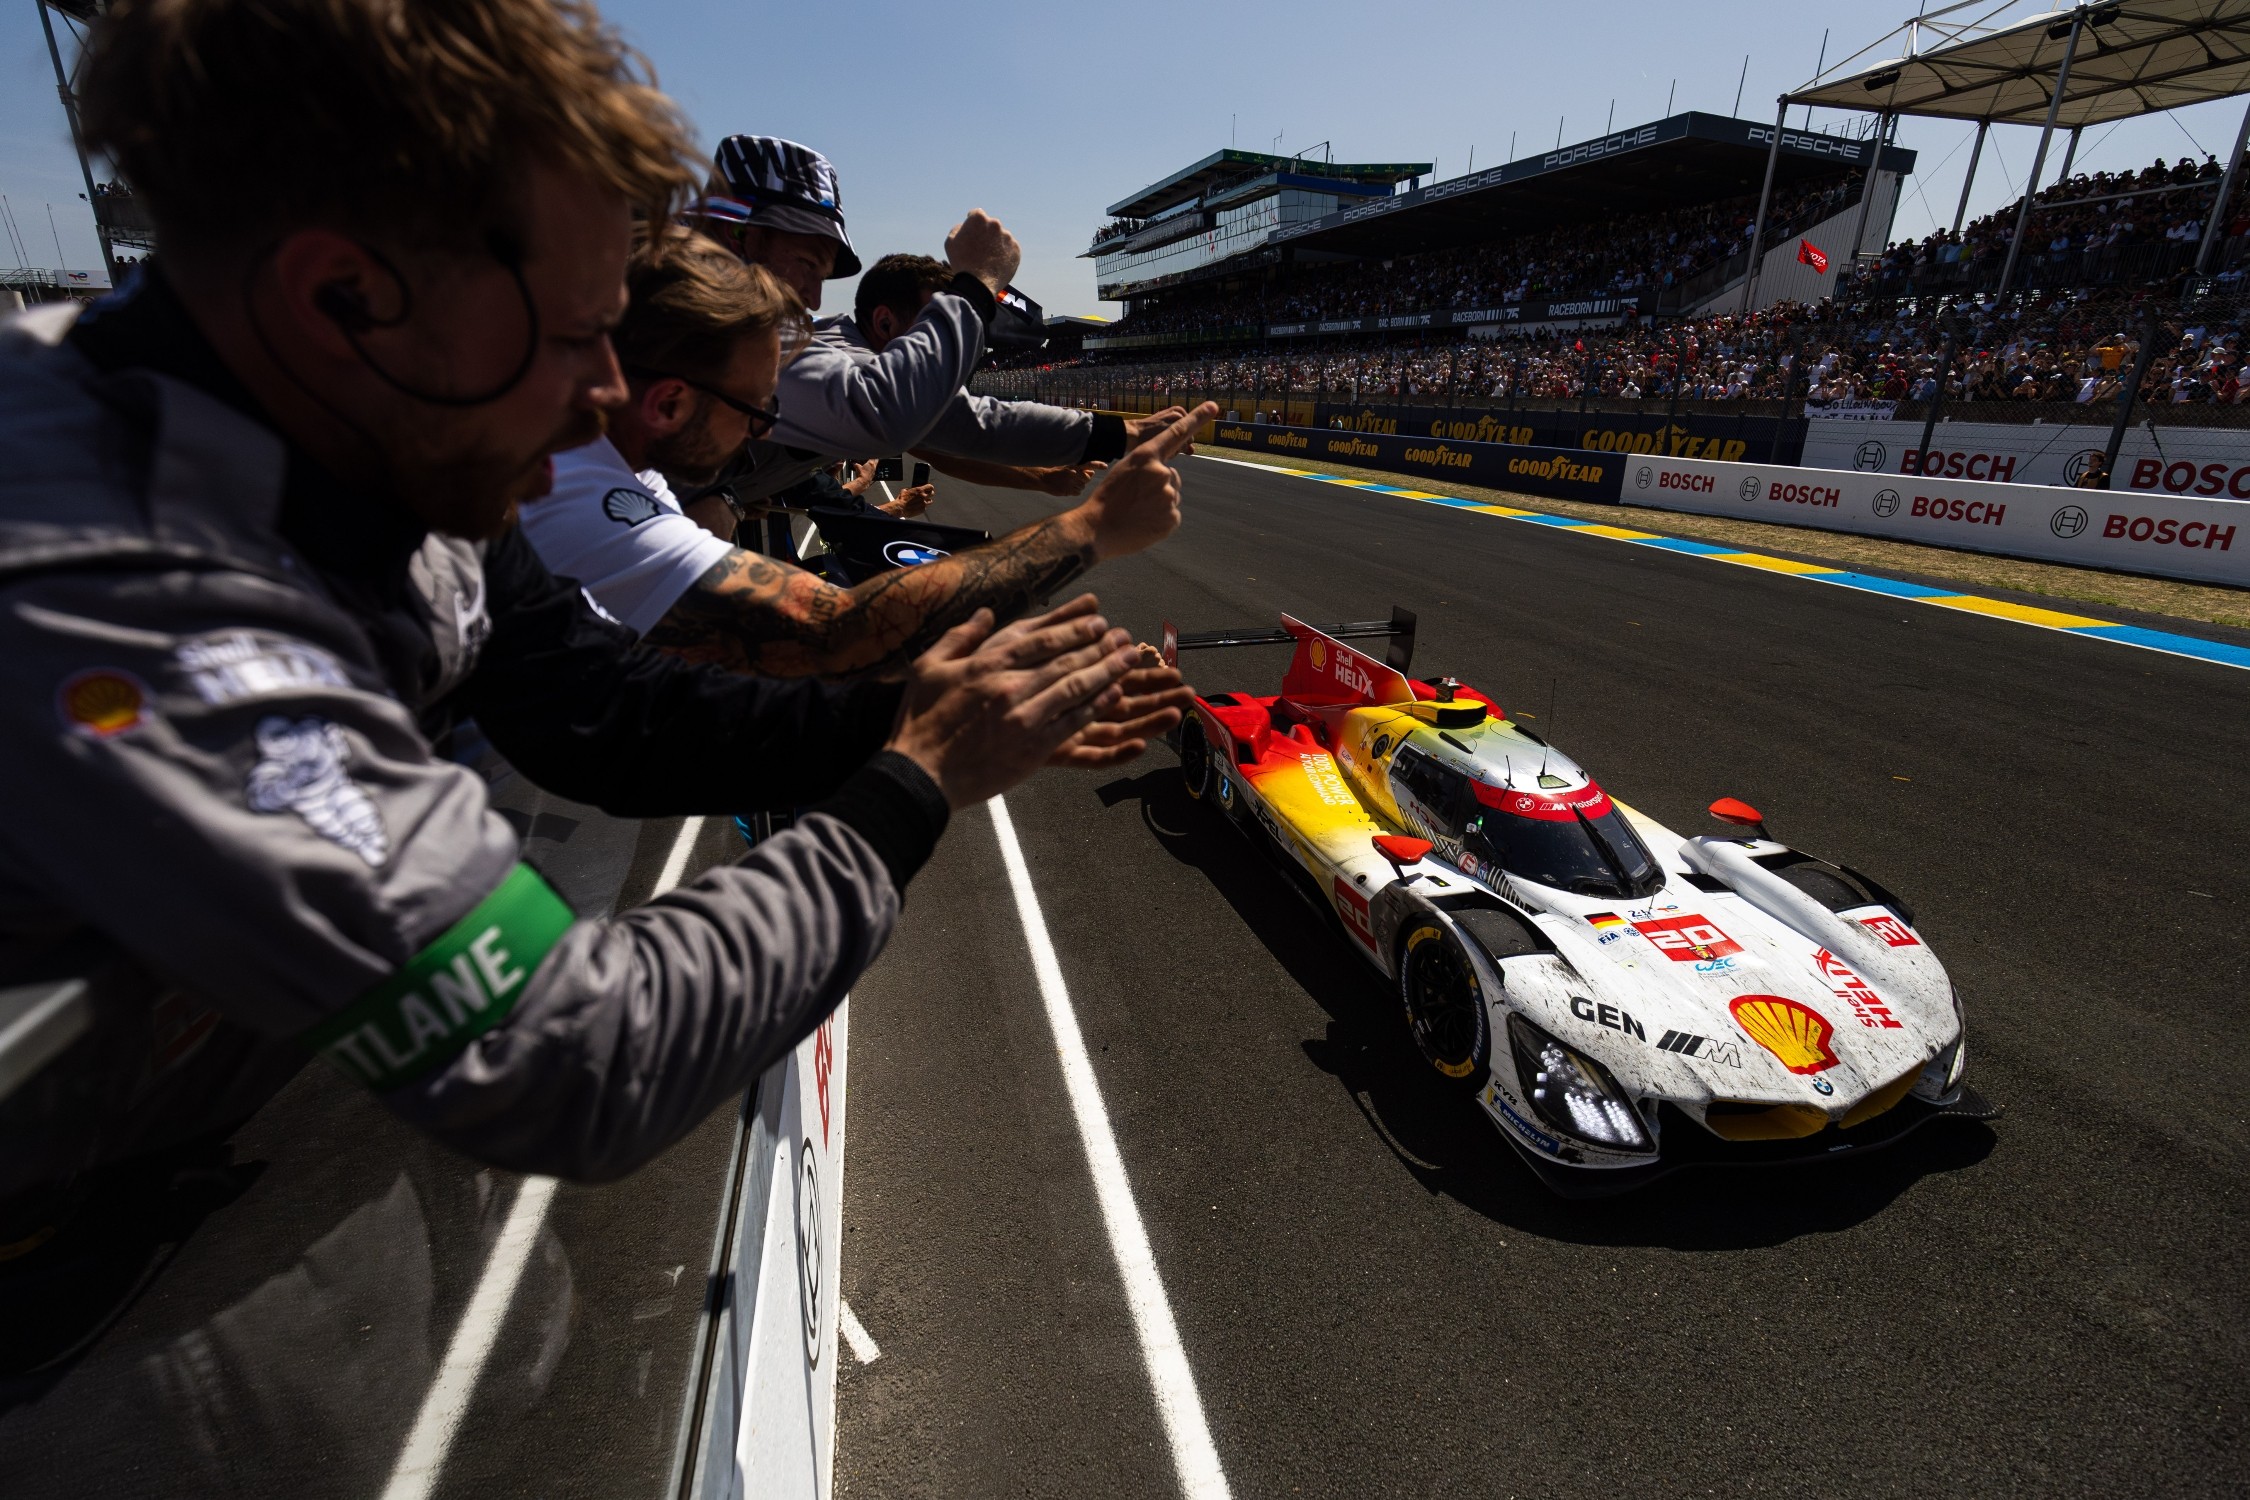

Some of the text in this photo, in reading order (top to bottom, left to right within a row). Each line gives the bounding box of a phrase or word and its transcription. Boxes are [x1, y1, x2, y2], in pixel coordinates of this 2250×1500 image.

[1544, 126, 1658, 168] PORSCHE
[1747, 127, 1861, 159] PORSCHE
[1424, 170, 1503, 200] PORSCHE
[1343, 197, 1402, 221] PORSCHE
[1276, 220, 1322, 239] PORSCHE
[1378, 315, 1405, 328] RACBORN
[1452, 307, 1520, 322] RACEBORN 75
[1549, 301, 1594, 316] RACEBORN
[1319, 322, 1341, 332] RACEBORN
[1220, 428, 1252, 442] GOODYEAR
[1268, 433, 1308, 449] GOODYEAR
[1582, 428, 1747, 462] GOODYEAR
[1328, 440, 1379, 457] GOODYEAR
[1404, 447, 1473, 468] GOODYEAR
[1508, 457, 1603, 484] GOODYEAR
[1900, 449, 2017, 483] BOSCH
[2130, 458, 2250, 499] BOSC
[1659, 472, 1715, 493] BOSCH
[1769, 482, 1841, 508] BOSCH
[1910, 496, 2007, 526] BOSCH
[2103, 514, 2237, 551] BOSCH
[1336, 649, 1353, 669] Shell
[1335, 663, 1376, 700] HELIX
[1311, 753, 1356, 806] 100% POWER
[1336, 891, 1375, 938] 20
[1598, 932, 1620, 945] FIA
[1645, 924, 1728, 950] 20
[1695, 957, 1737, 972] WEC
[1810, 947, 1904, 1029] HELIX
[1570, 996, 1647, 1043] GEN
[1833, 990, 1880, 1028] Shell
[1503, 1109, 1551, 1147] MICHELIN
